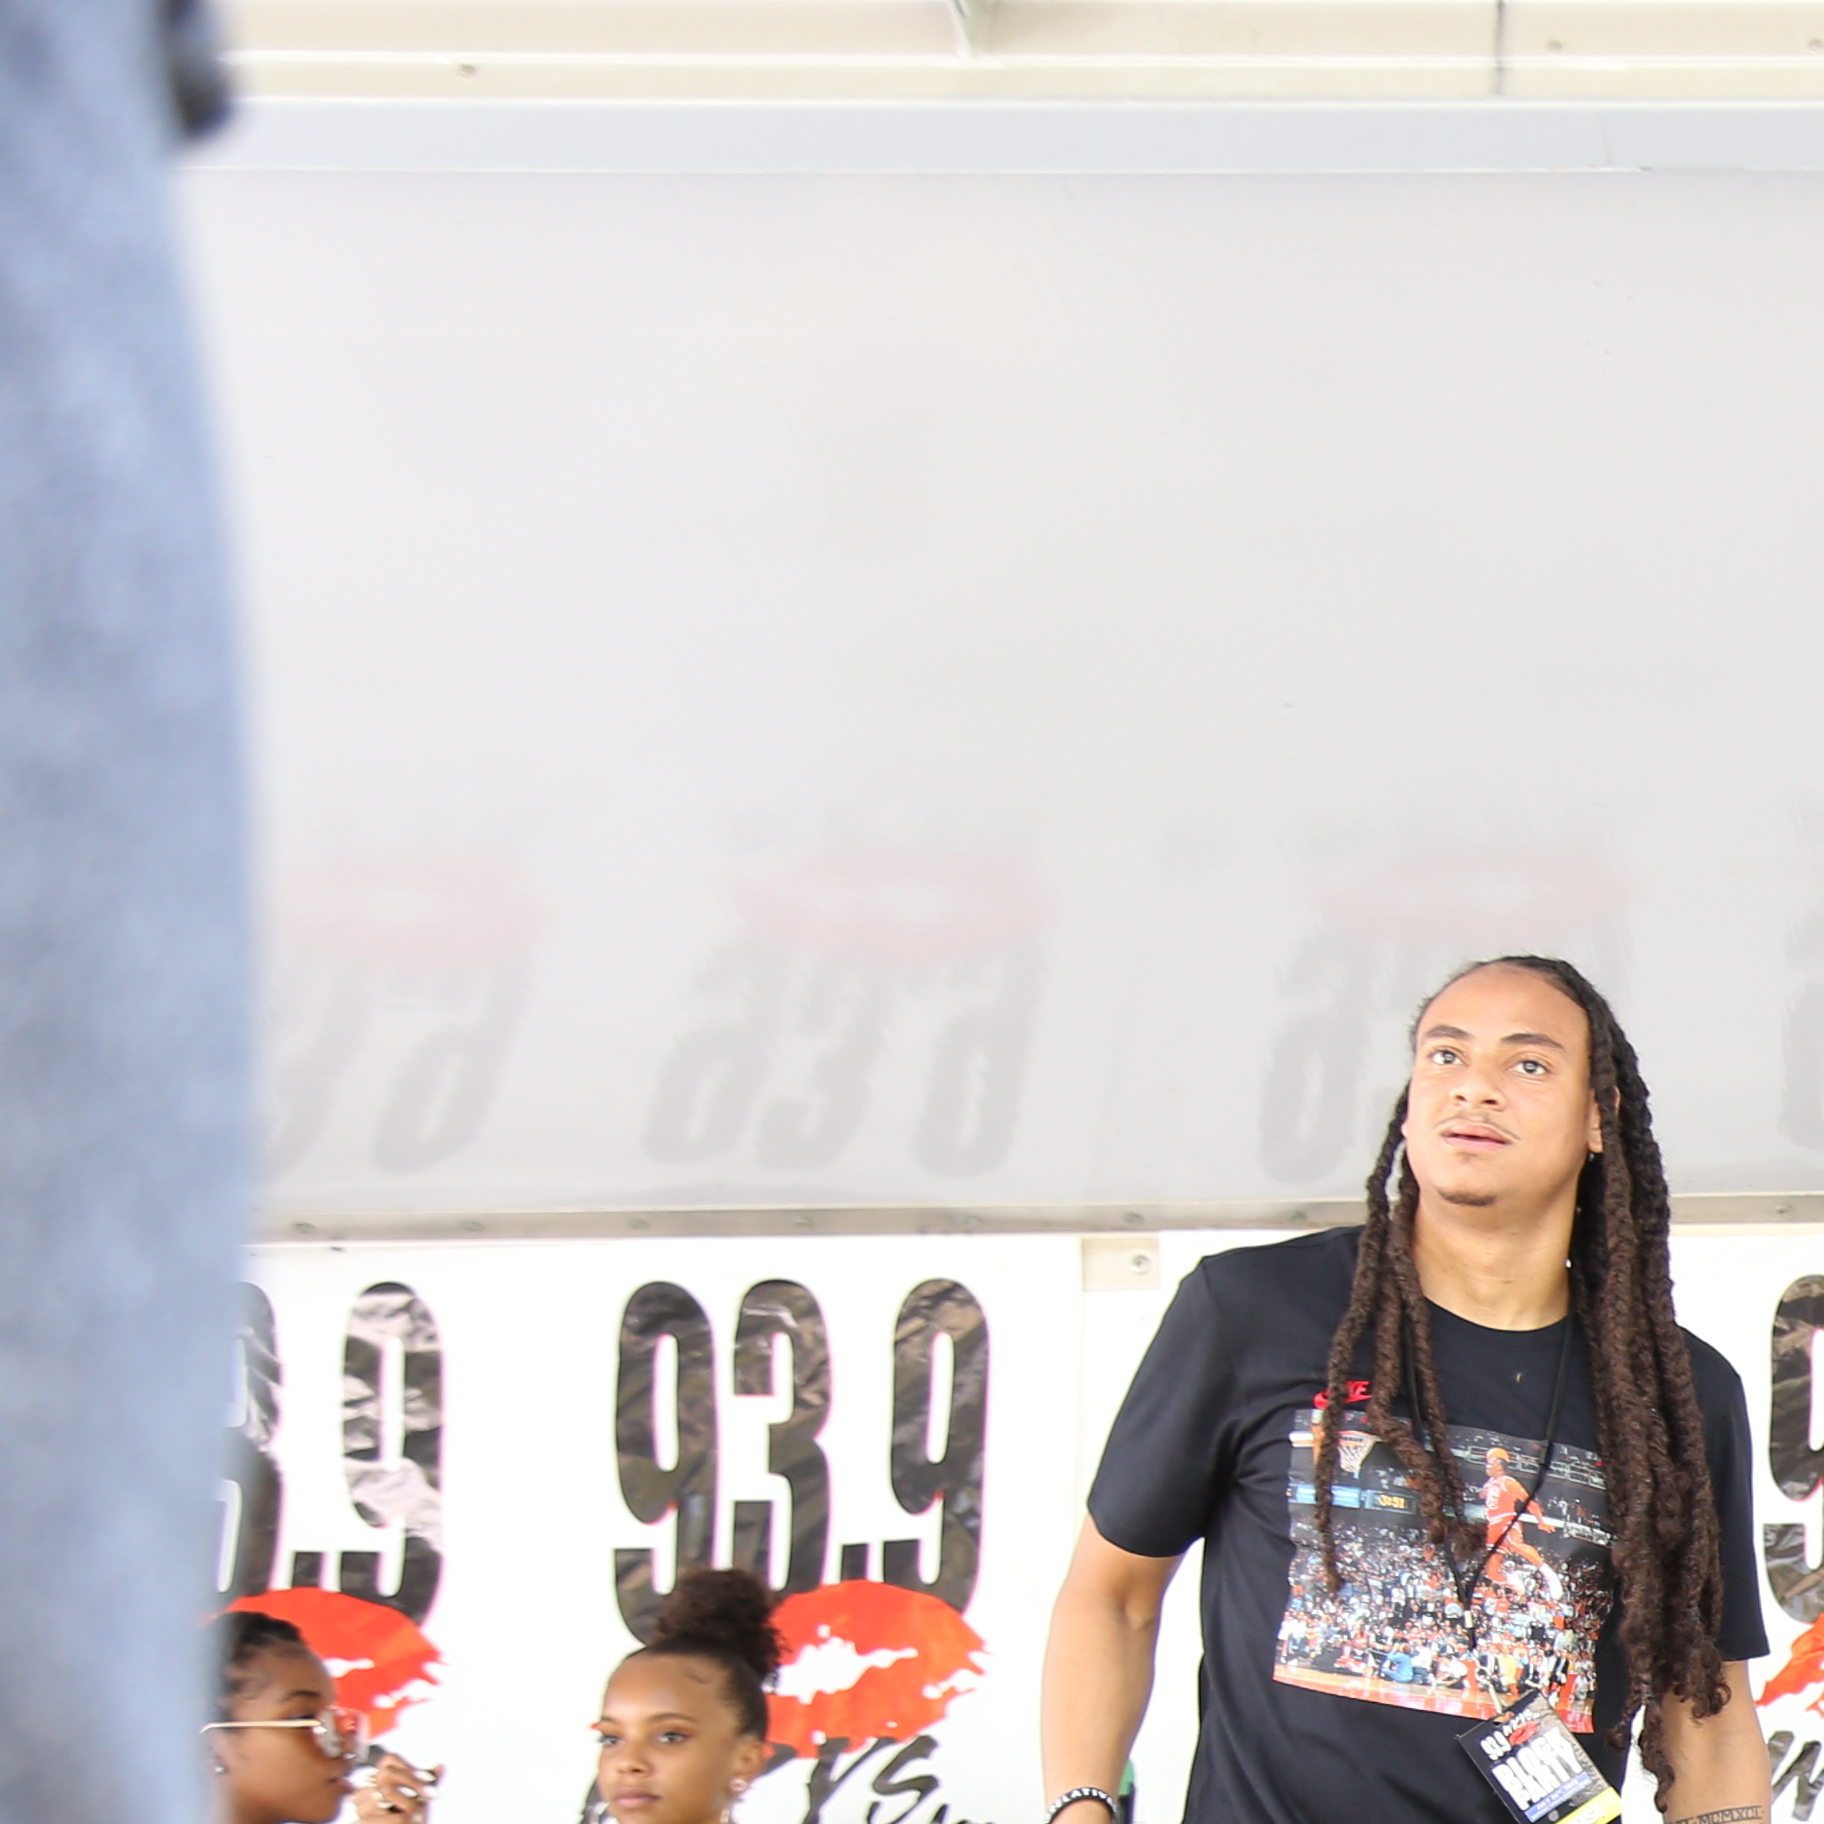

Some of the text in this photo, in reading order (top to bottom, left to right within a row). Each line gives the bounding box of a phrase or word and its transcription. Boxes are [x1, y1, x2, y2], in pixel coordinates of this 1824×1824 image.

[612, 1279, 990, 1648] 93.9
[1491, 1726, 1573, 1791] BLOCK
[1508, 1746, 1584, 1811] PARTY
